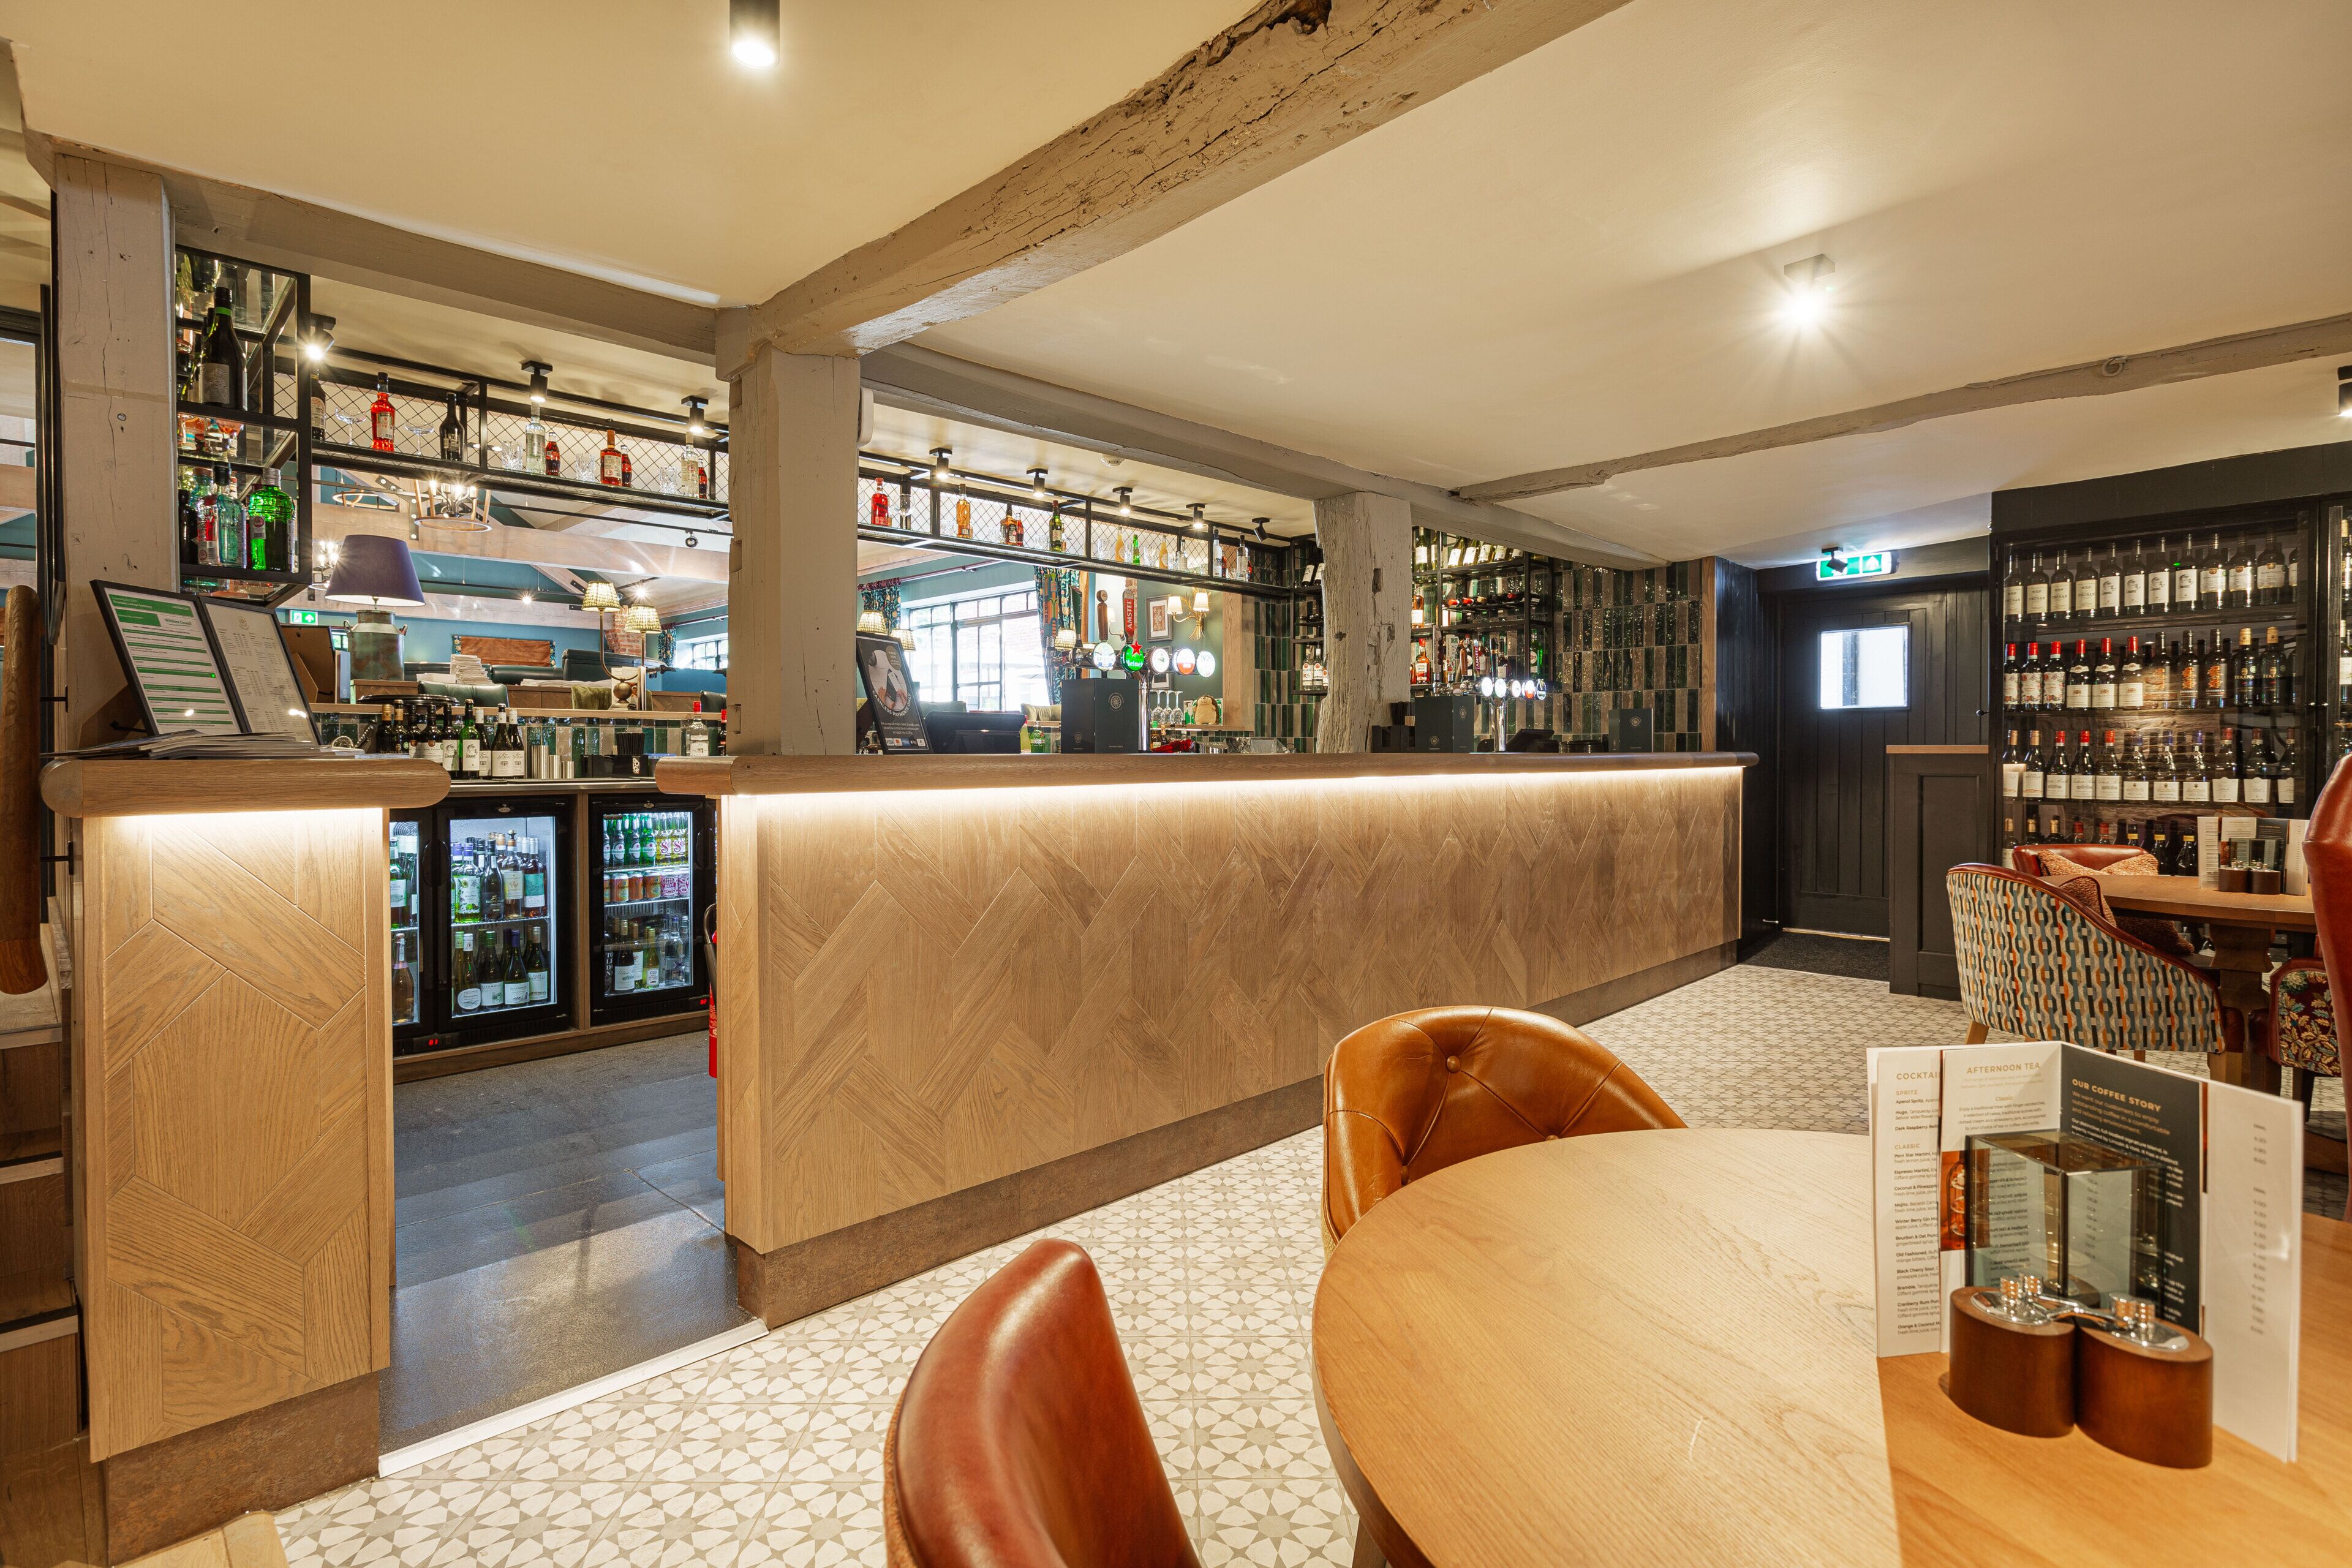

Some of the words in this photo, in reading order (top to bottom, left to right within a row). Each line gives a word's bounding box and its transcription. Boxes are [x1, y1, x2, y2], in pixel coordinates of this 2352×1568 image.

[872, 690, 892, 715] CASHLESS
[892, 706, 910, 717] PAYMENTS
[1896, 1071, 1939, 1080] COCKTAI
[1966, 1064, 2022, 1074] AFTERNOON
[2071, 1079, 2090, 1090] OUR
[2091, 1085, 2126, 1102] COFFEE
[2128, 1096, 2162, 1112] STORY
[2071, 1099, 2103, 1114] outstanding
[2103, 1110, 2120, 1120] coffee
[2132, 1120, 2171, 1136] comfortable
[2104, 1102, 2134, 1115] customers
[2142, 1115, 2160, 1124] enjoy
